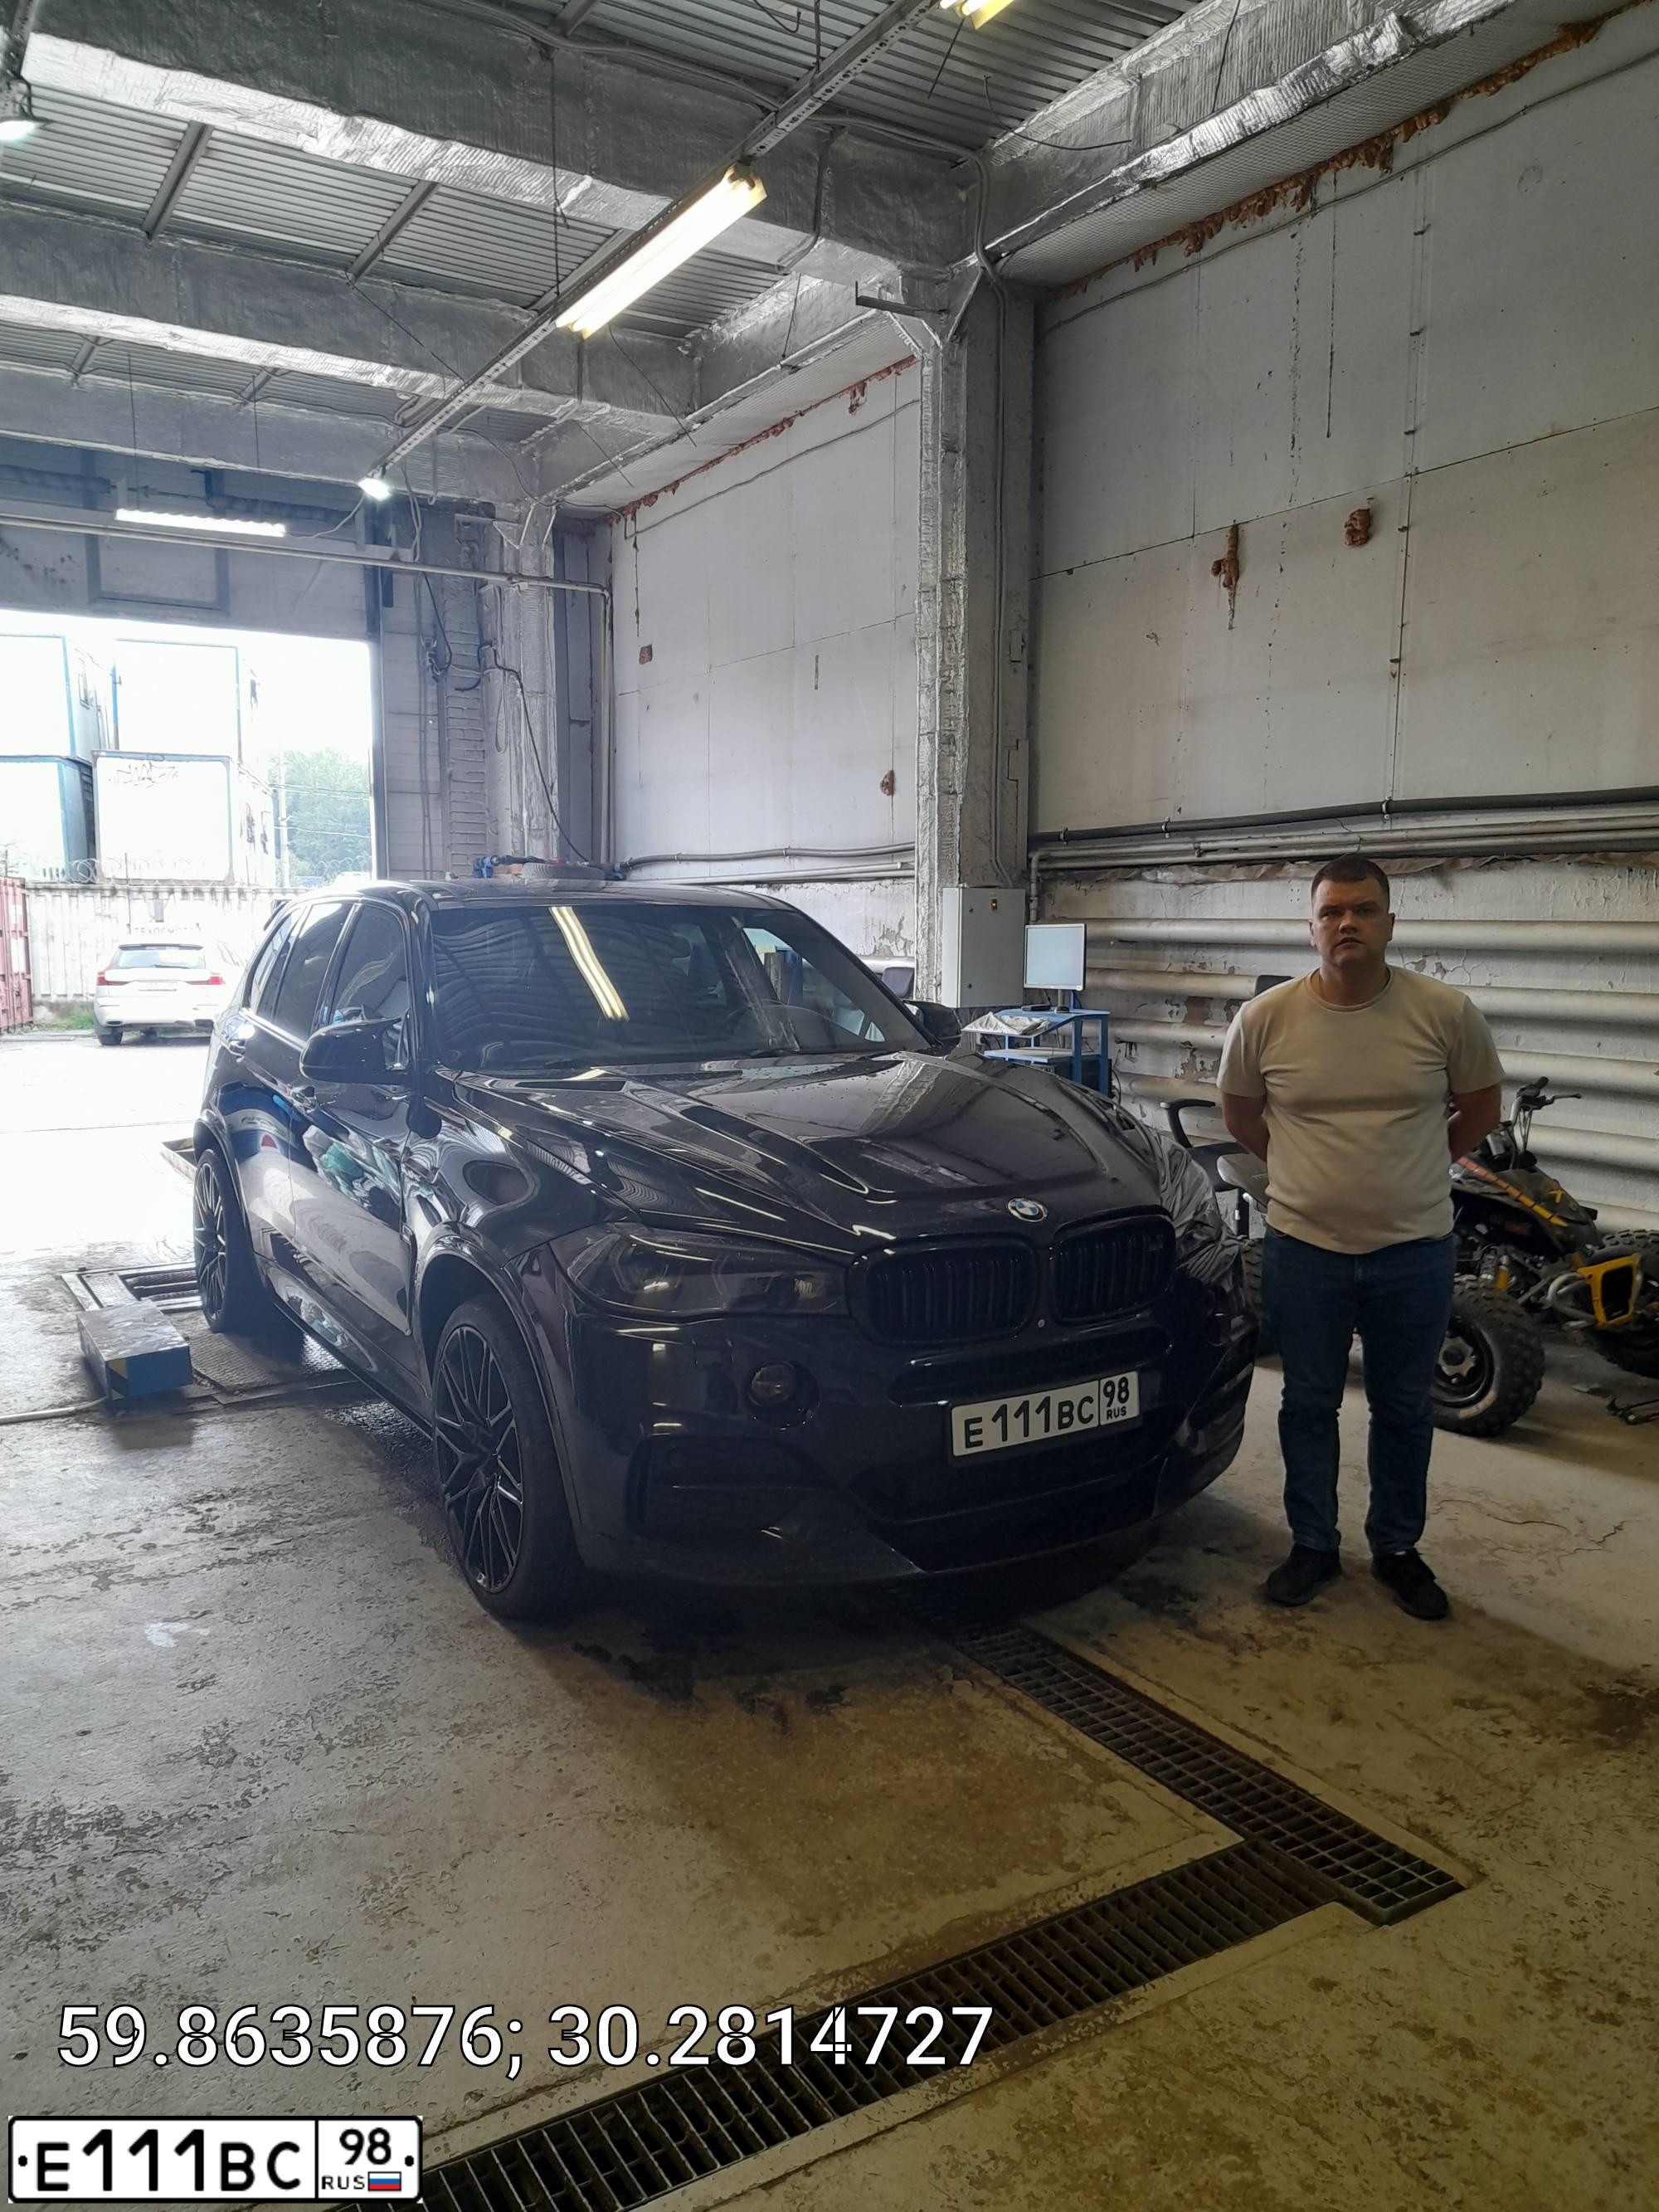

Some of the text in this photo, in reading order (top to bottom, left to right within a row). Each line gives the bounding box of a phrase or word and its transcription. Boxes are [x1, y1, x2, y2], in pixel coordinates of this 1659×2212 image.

[964, 1376, 1130, 1449] Е111ВС 98
[1106, 1406, 1127, 1421] RUS
